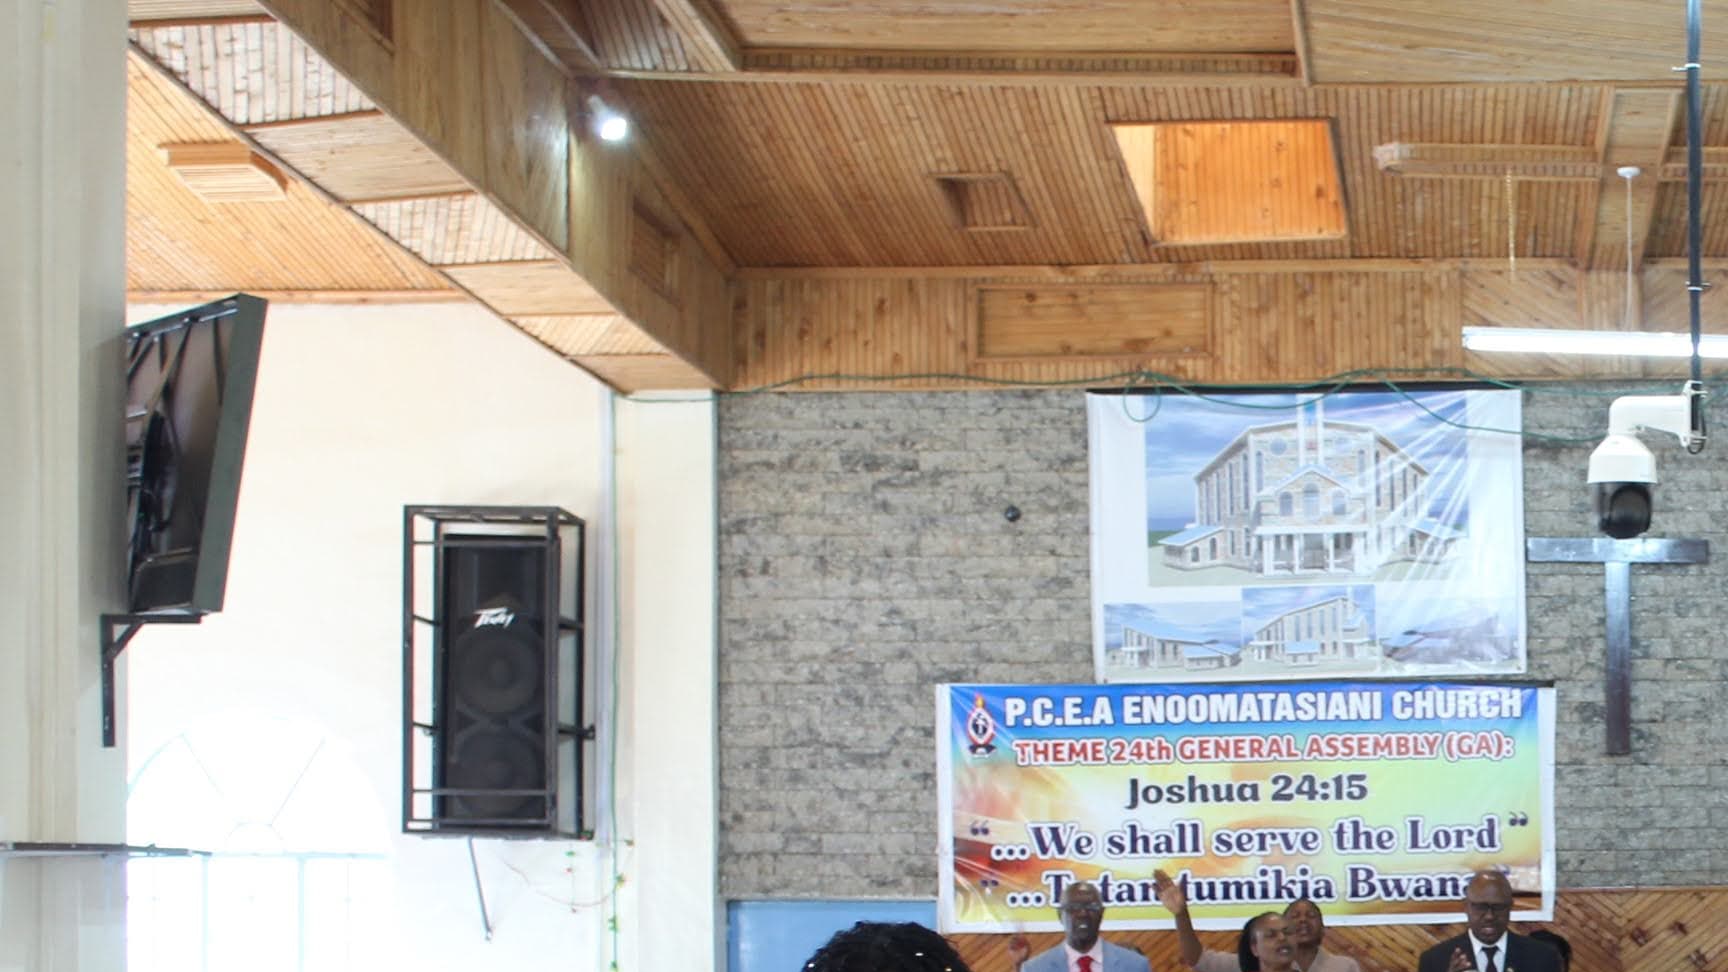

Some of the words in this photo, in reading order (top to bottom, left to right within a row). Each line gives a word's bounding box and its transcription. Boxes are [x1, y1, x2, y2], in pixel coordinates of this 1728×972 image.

[1004, 696, 1114, 727] P.C.E.A
[1122, 690, 1383, 725] ENOOMATASIANI
[1391, 689, 1522, 720] CHURCH
[1014, 739, 1105, 766] THEME
[1111, 738, 1172, 763] 24th
[1178, 734, 1300, 763] GENERAL
[1306, 732, 1441, 759] ASSEMBLY
[1446, 731, 1515, 760] (GA):
[1124, 775, 1261, 810] Joshua
[1270, 774, 1368, 802] 24:15
[1106, 822, 1201, 855] shall
[1214, 828, 1319, 855] serve
[1333, 819, 1395, 851] the
